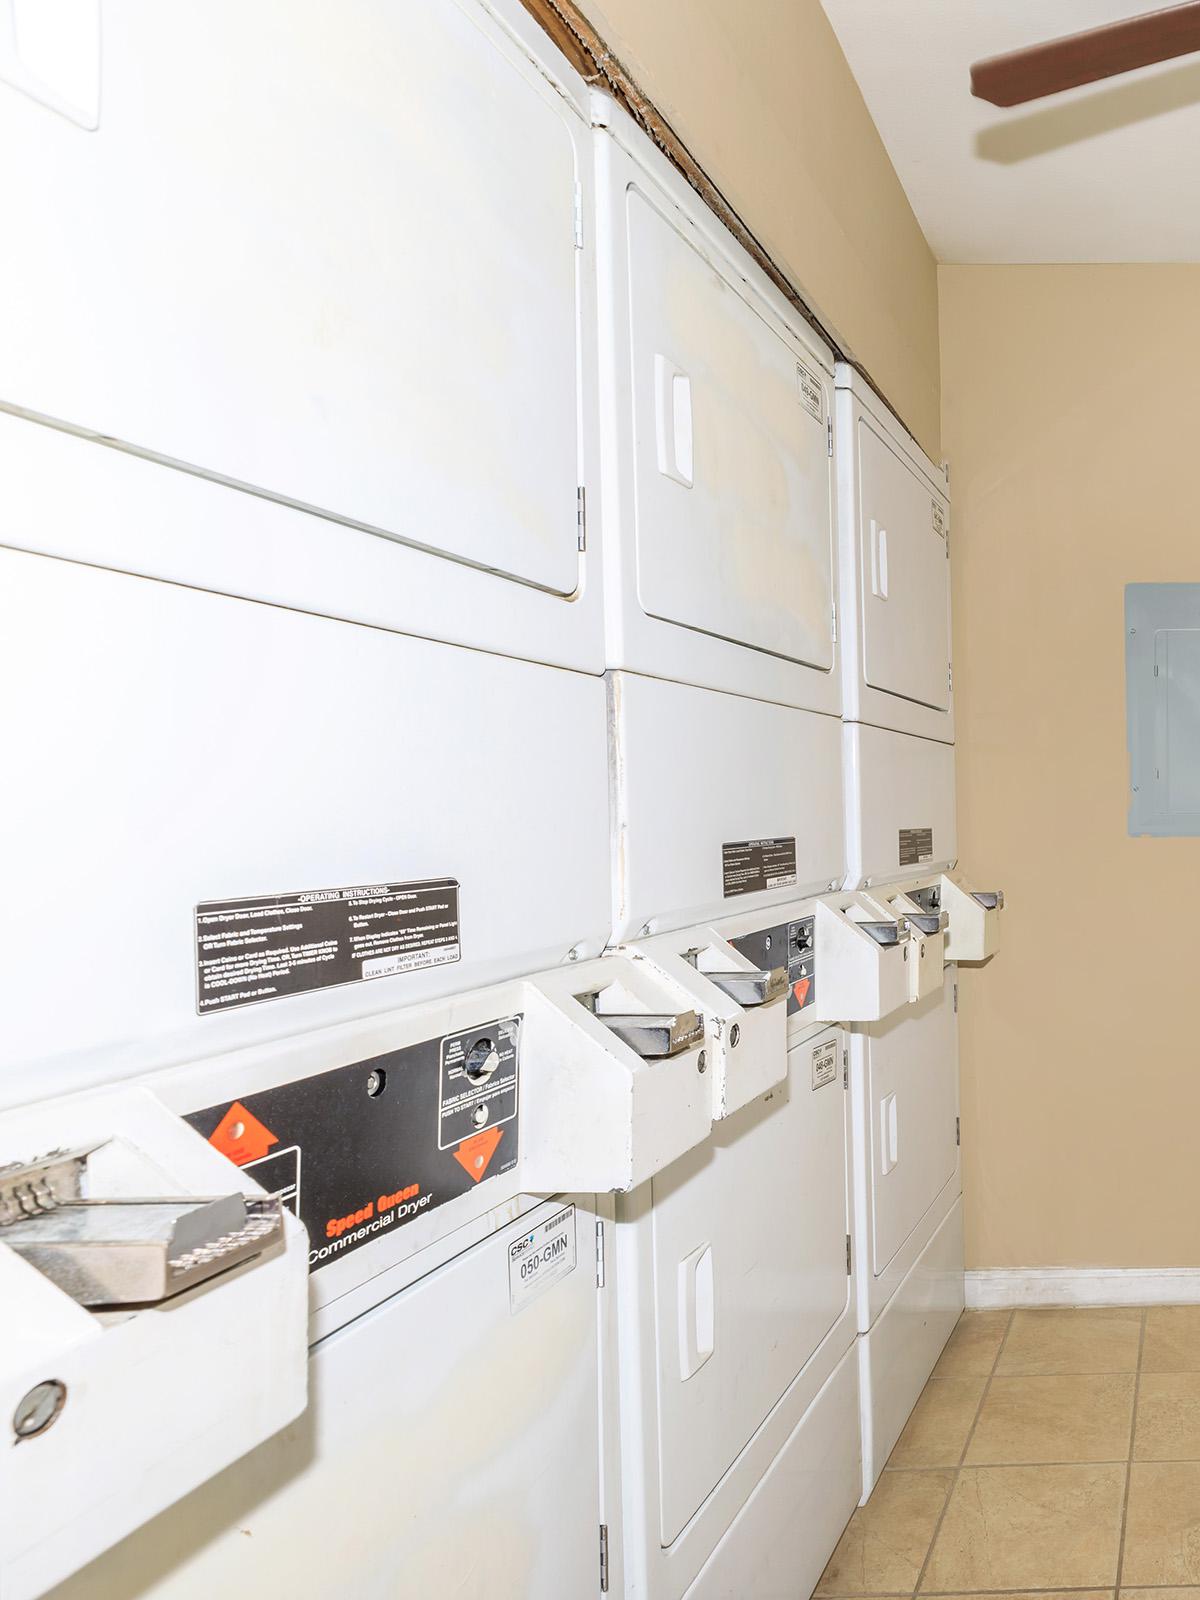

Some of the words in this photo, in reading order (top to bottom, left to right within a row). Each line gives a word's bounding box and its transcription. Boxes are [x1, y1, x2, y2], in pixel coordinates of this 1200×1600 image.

[369, 897, 382, 905] Drying
[219, 913, 234, 923] Dryer
[250, 910, 263, 918] Load
[285, 906, 299, 914] Close
[222, 931, 239, 939] Fabric
[240, 929, 250, 937] and
[251, 925, 282, 936] Temperature
[283, 923, 303, 932] Settings
[214, 941, 226, 949] Turn
[226, 938, 244, 947] Fabric
[221, 955, 237, 964] Coins
[245, 952, 258, 960] Card
[301, 942, 324, 951] Additional
[204, 973, 222, 982] obtain
[244, 966, 262, 976] Drying
[322, 954, 335, 962] Cycle
[211, 965, 225, 973] Card
[235, 961, 249, 969] more
[249, 958, 267, 968] Drying
[366, 969, 382, 977] CLEAN
[397, 963, 412, 971] FILTER
[415, 959, 432, 967] BEFORE
[220, 993, 239, 1003] START
[443, 1095, 460, 1108] FABRIC
[460, 1085, 483, 1100] SELECTOR
[326, 1202, 374, 1238] Speed
[377, 1183, 420, 1213] Queen
[308, 1207, 394, 1265] Commercial
[398, 1193, 433, 1220] Dryer
[511, 1239, 529, 1256] CSC
[520, 1234, 568, 1279] 050-GMN
